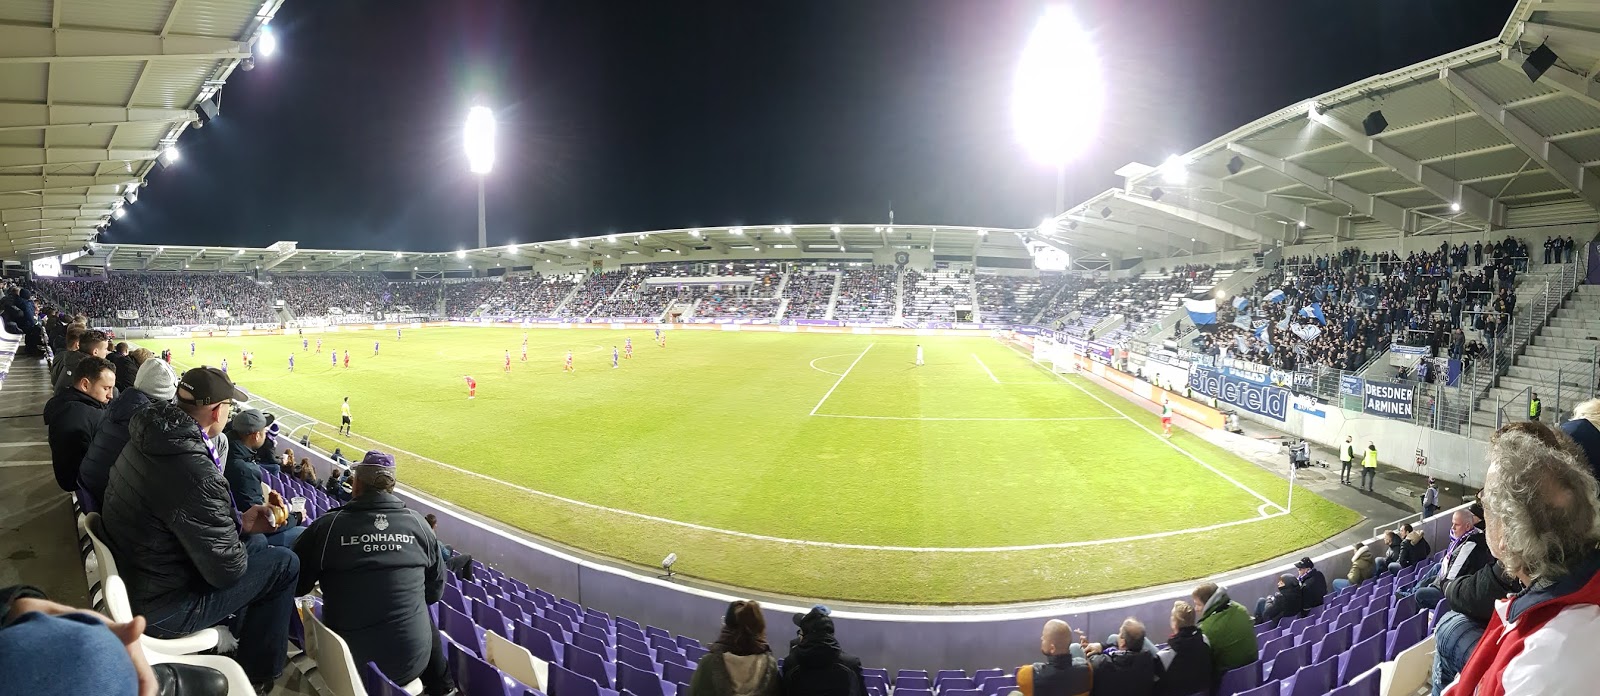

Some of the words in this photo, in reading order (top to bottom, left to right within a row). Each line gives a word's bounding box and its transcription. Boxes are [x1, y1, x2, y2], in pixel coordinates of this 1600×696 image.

[1190, 369, 1288, 418] Bielefeld
[1366, 384, 1412, 400] DRESDNER
[1368, 398, 1412, 415] ARMINEN
[340, 533, 416, 546] LEONHARDT
[363, 544, 402, 552] GROUP
